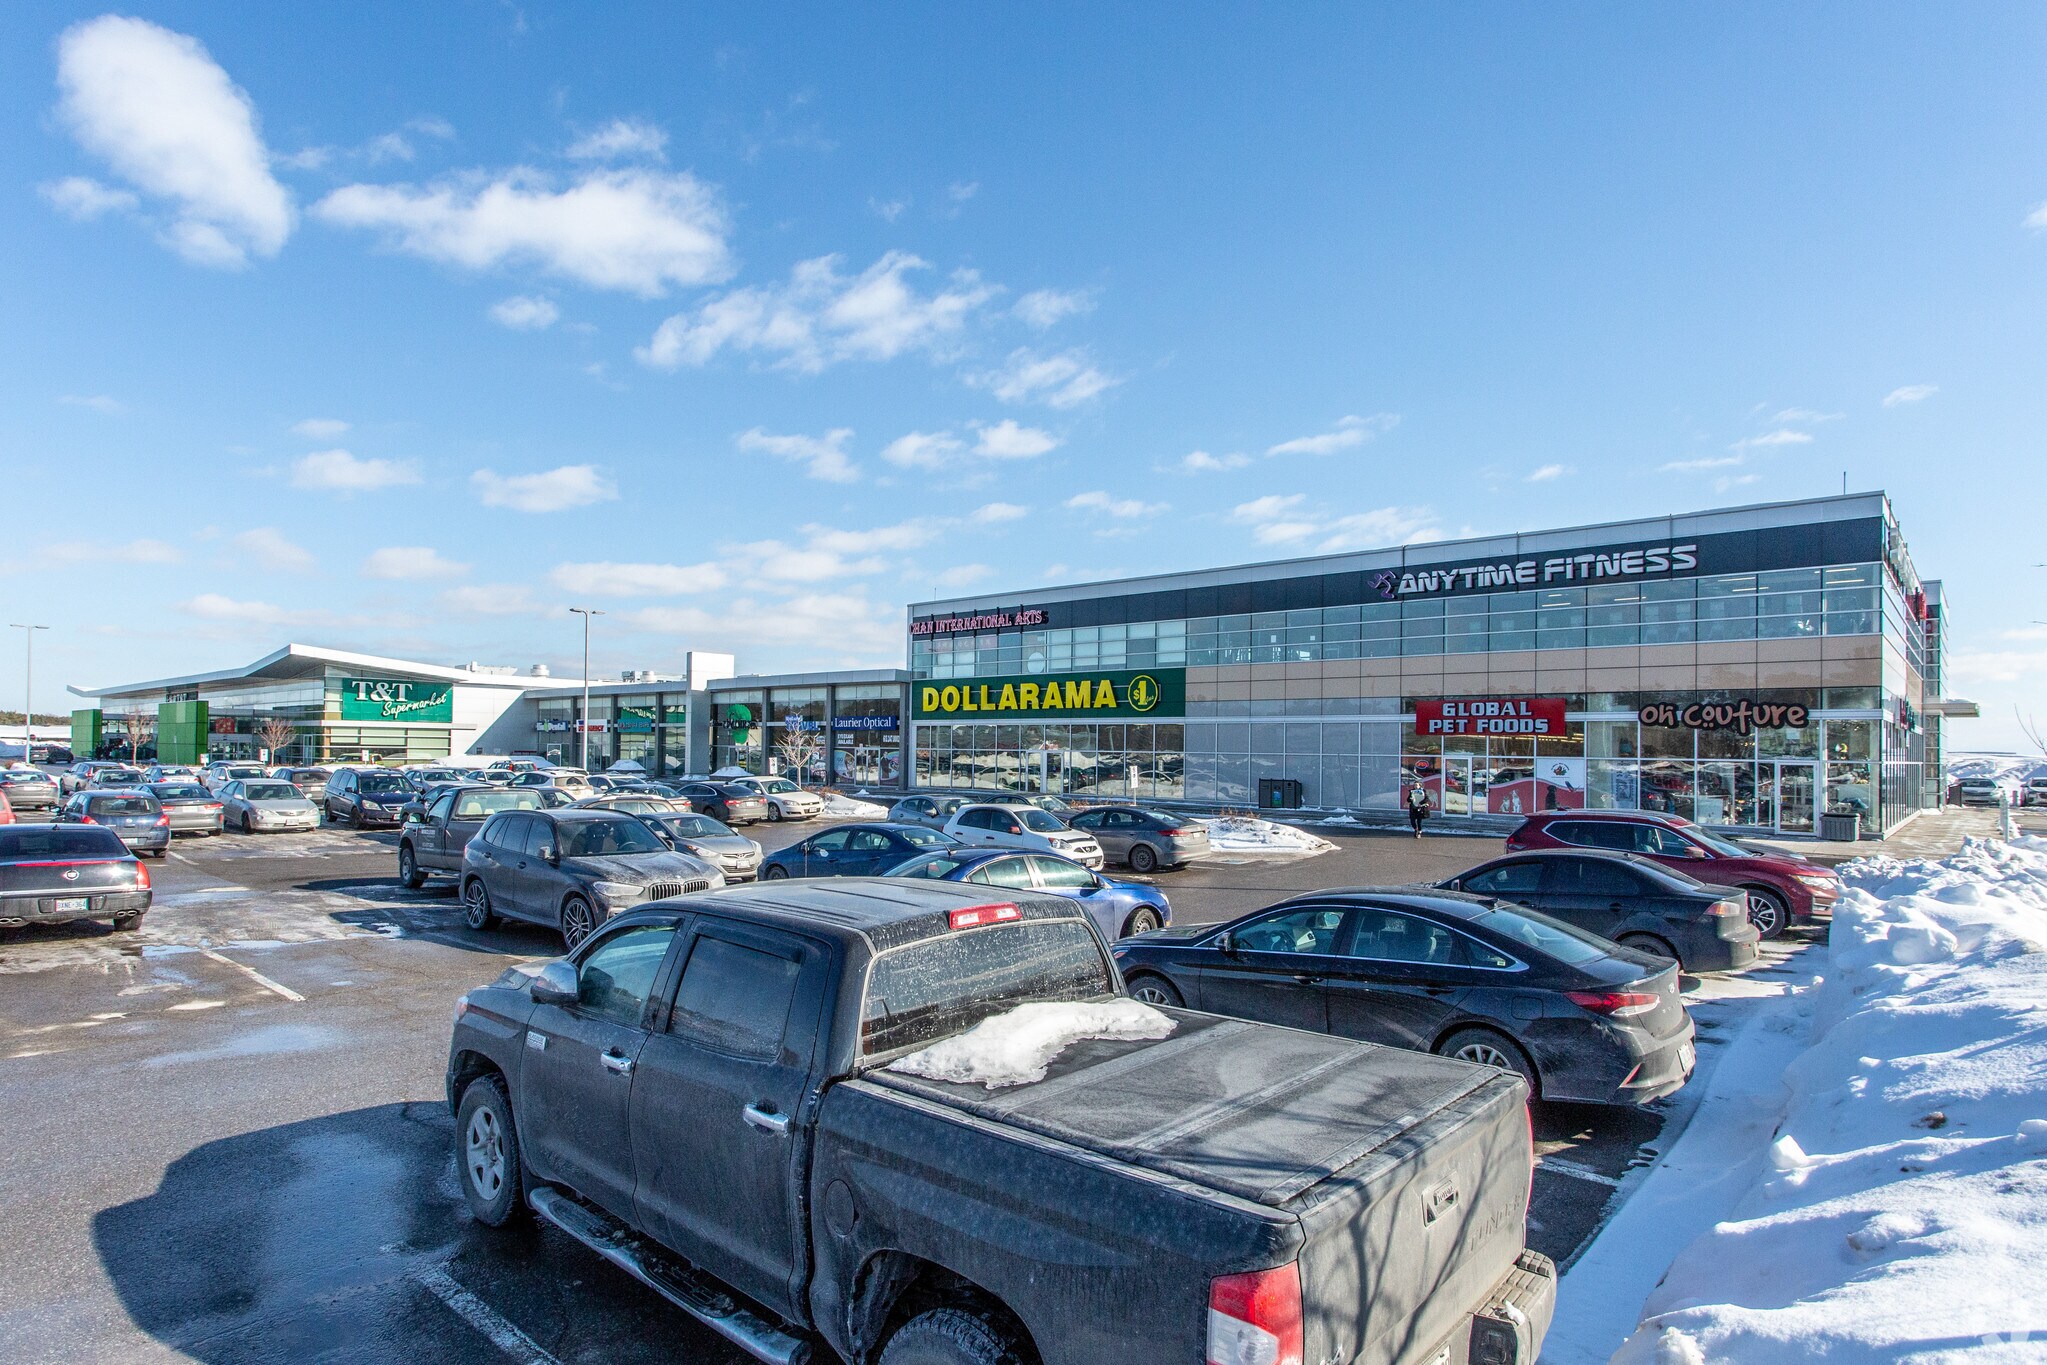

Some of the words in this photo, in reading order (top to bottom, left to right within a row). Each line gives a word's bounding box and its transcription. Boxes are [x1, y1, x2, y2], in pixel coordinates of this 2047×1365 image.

[1398, 561, 1537, 593] ANYTIME
[1545, 545, 1697, 581] FITNESS
[909, 621, 934, 635] CHAN
[935, 613, 1012, 633] INTERNATIONAL
[1015, 610, 1043, 626] ARTS
[351, 681, 413, 702] T&T
[923, 679, 1117, 712] DOLLARAMA
[382, 692, 447, 718] Supermarket
[1442, 701, 1532, 717] GLOBAL
[1684, 701, 1806, 733] couture
[834, 717, 862, 728] Laurier
[863, 716, 892, 729] Optical
[1429, 719, 1468, 733] PET
[1477, 718, 1549, 733] FOODS
